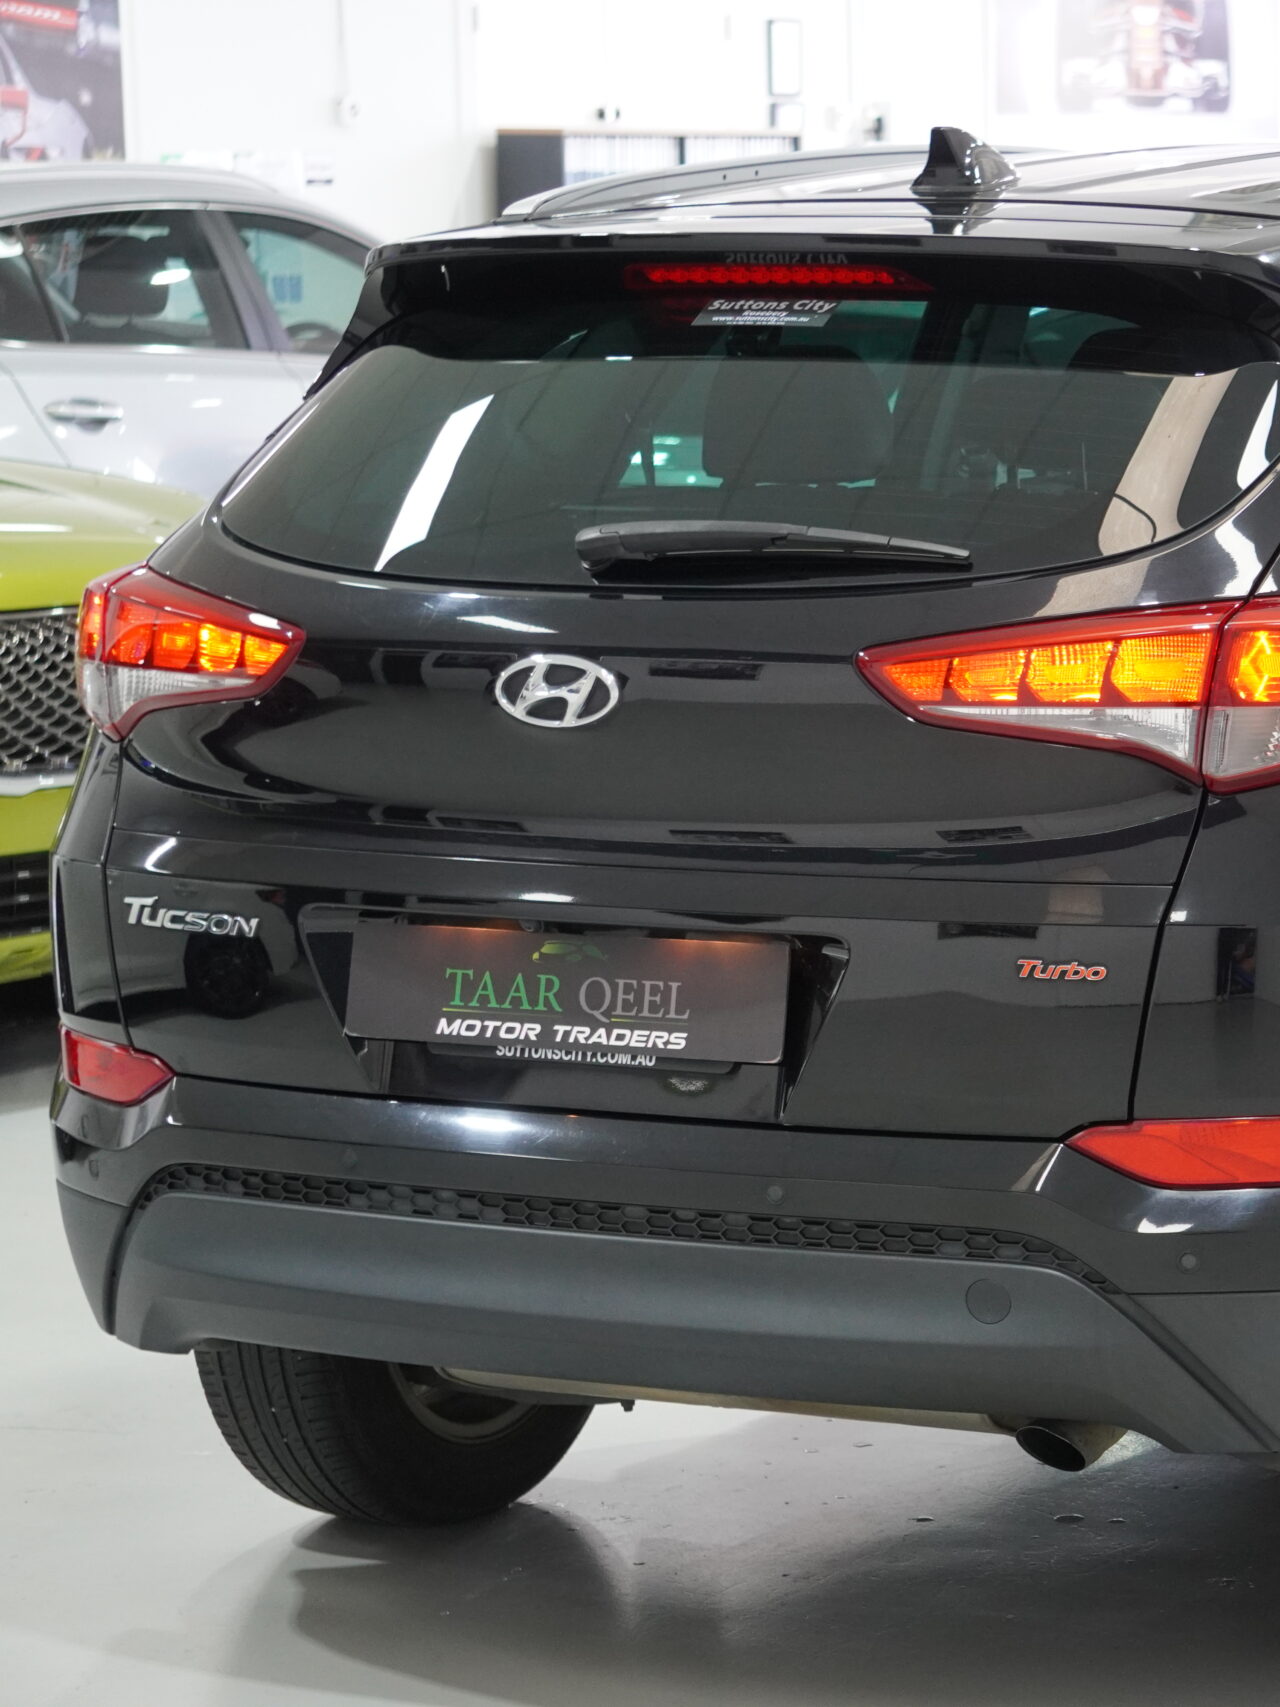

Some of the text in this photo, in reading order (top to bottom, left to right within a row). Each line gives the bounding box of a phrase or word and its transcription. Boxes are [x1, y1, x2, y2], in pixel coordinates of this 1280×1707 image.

[707, 299, 837, 313] Suttons City
[1017, 959, 1107, 981] Turbo
[445, 968, 690, 1023] TAAR QEEL
[435, 1017, 688, 1050] MOTOR TRADERS
